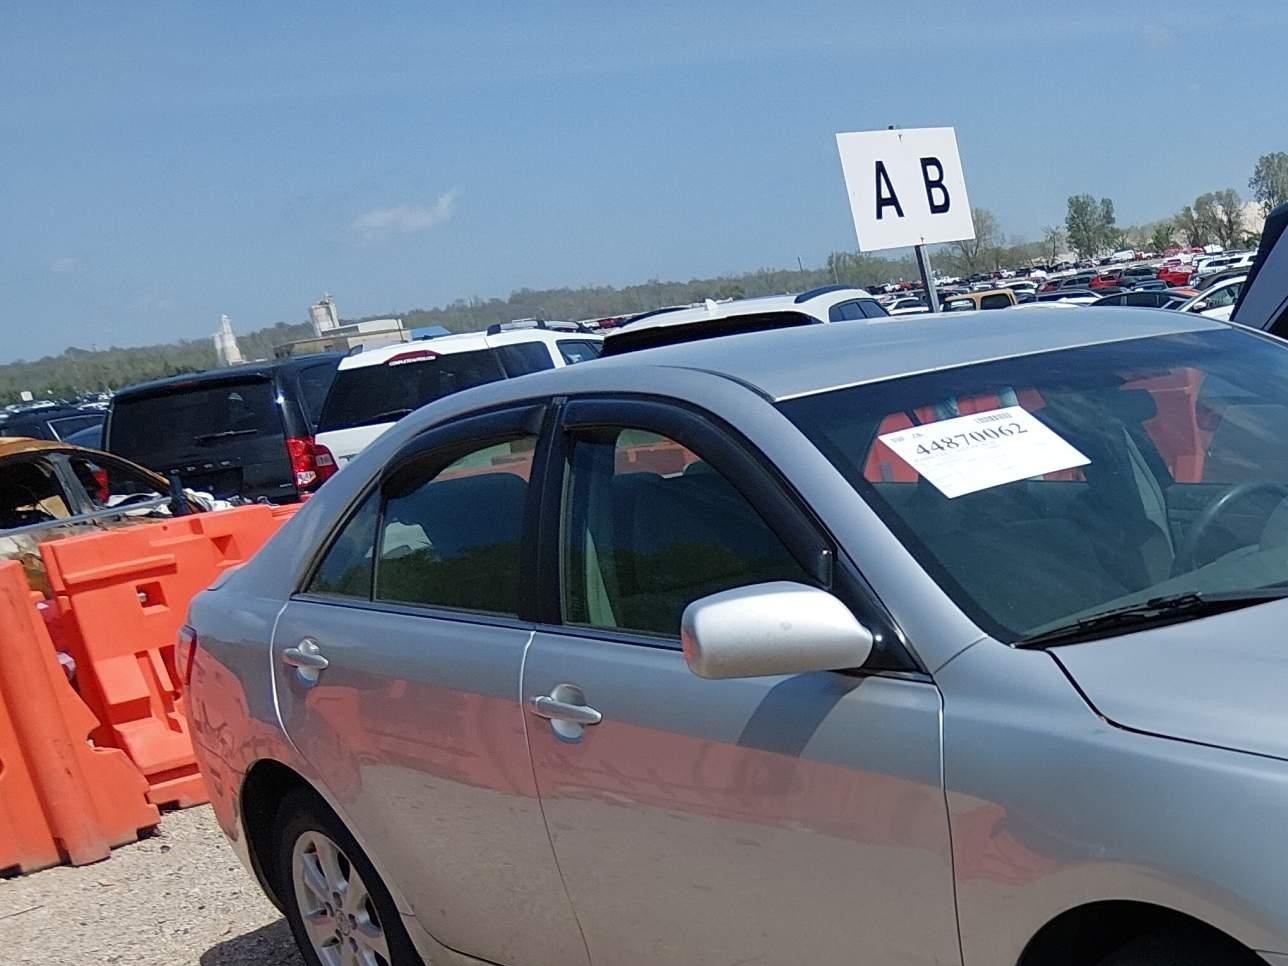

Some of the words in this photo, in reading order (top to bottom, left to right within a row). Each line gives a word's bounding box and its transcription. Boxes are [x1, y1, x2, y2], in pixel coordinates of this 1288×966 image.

[875, 160, 905, 221] A
[919, 156, 951, 215] B
[915, 422, 1028, 456] 44870062
